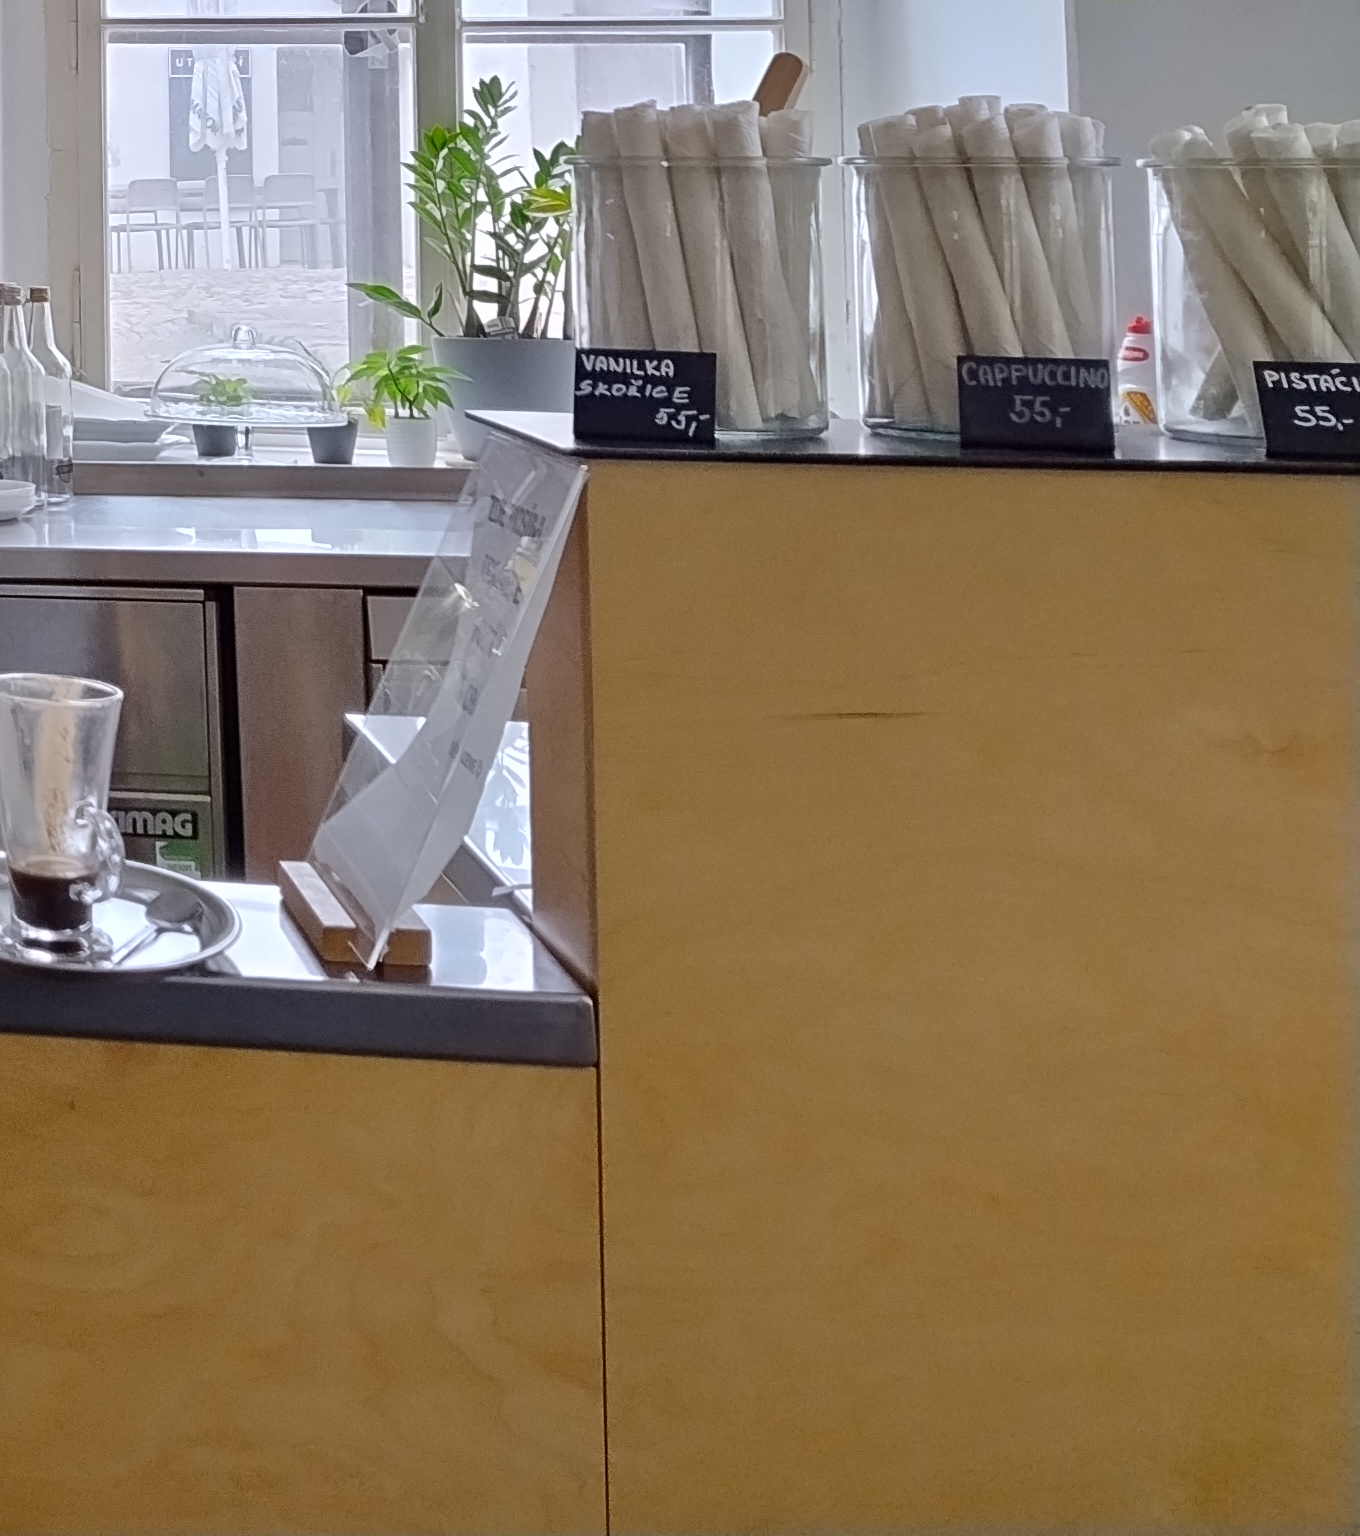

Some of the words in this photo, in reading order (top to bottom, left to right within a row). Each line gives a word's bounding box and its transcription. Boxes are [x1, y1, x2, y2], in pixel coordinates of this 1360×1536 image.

[582, 354, 674, 376] VANILKA
[961, 362, 1109, 388] CAPPUCCINO
[1009, 395, 1071, 427] 55,-
[1293, 405, 1354, 432] 55,-
